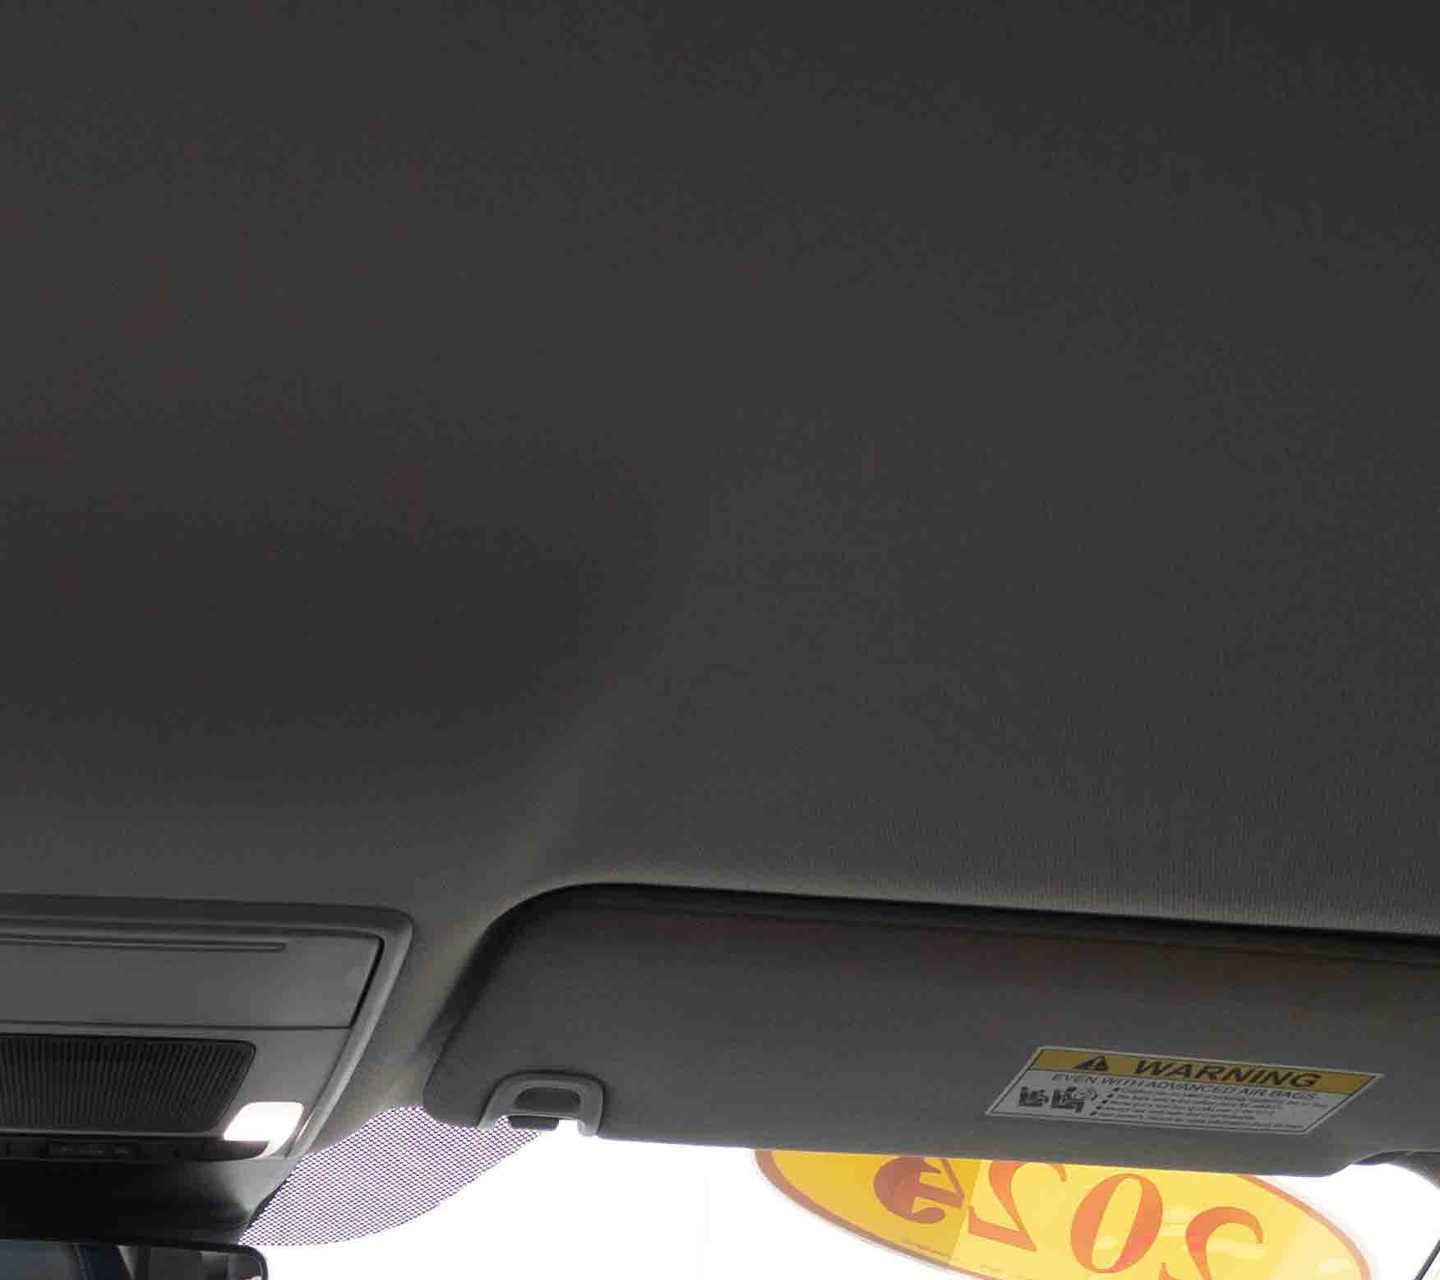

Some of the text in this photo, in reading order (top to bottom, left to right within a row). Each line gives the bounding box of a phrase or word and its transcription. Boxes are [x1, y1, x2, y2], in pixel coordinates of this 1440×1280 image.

[1051, 1073, 1317, 1101] EVEN WITH ADVANCED AIR BAGS
[1133, 1058, 1321, 1089] WARNING
